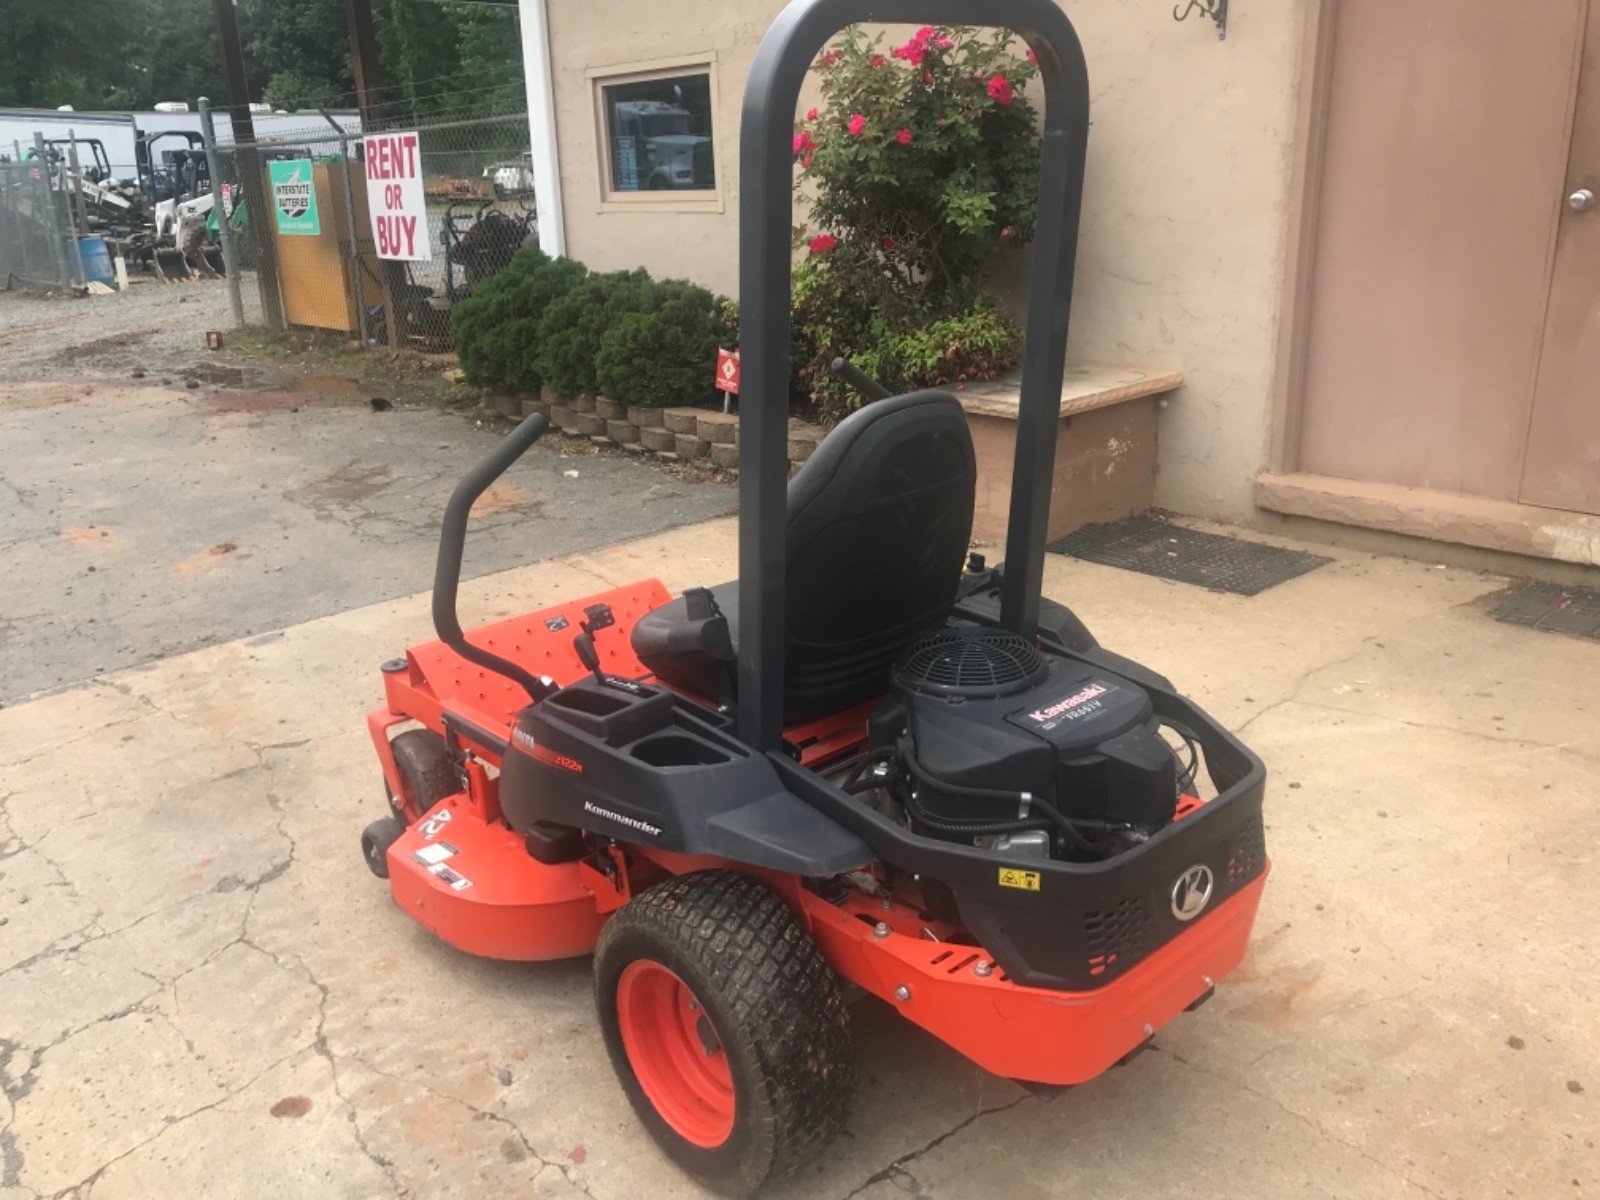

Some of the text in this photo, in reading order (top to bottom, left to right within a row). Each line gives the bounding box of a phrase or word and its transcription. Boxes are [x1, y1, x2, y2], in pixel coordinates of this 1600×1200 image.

[366, 136, 417, 180] RENT
[276, 184, 310, 195] INTERSTATE
[279, 197, 308, 208] BATTERIES
[385, 184, 403, 210] OR
[377, 216, 417, 256] BUY
[1029, 683, 1107, 722] Kawasaki
[584, 801, 662, 836] Kommander
